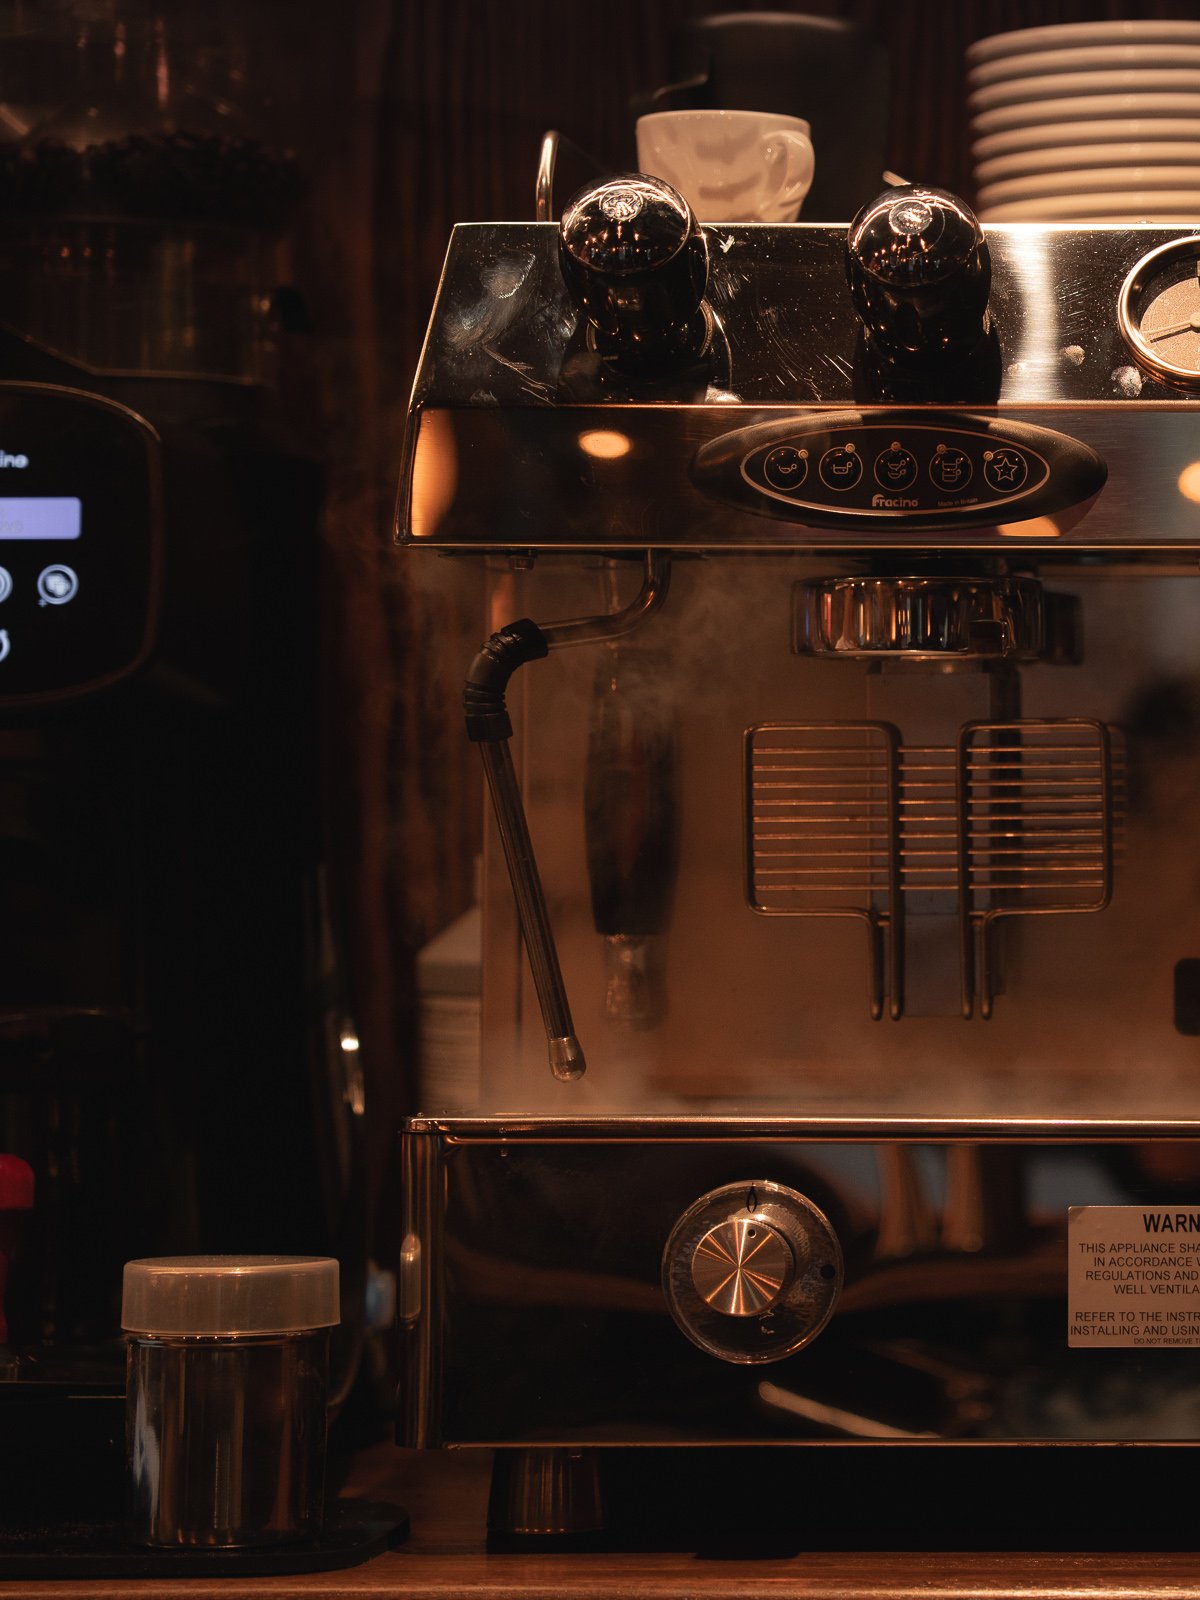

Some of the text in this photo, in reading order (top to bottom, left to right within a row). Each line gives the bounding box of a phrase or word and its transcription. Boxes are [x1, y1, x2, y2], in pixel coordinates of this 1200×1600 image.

[1079, 1243, 1106, 1254] THIS
[1109, 1243, 1175, 1254] APPLIANCE
[1094, 1256, 1105, 1267] IN
[1108, 1256, 1193, 1267] ACCORDANCE
[1086, 1270, 1171, 1281] REGULATIONS
[1173, 1270, 1199, 1281] AND
[1113, 1284, 1146, 1295] WELL
[1075, 1311, 1115, 1322] REFER
[1119, 1311, 1135, 1322] TO
[1139, 1311, 1162, 1322] THE
[1070, 1325, 1140, 1336] INSTALLING
[1143, 1325, 1168, 1336] AND
[1133, 1337, 1145, 1345] DO
[1146, 1337, 1162, 1345] NOT
[1163, 1337, 1193, 1345] REMOVE
